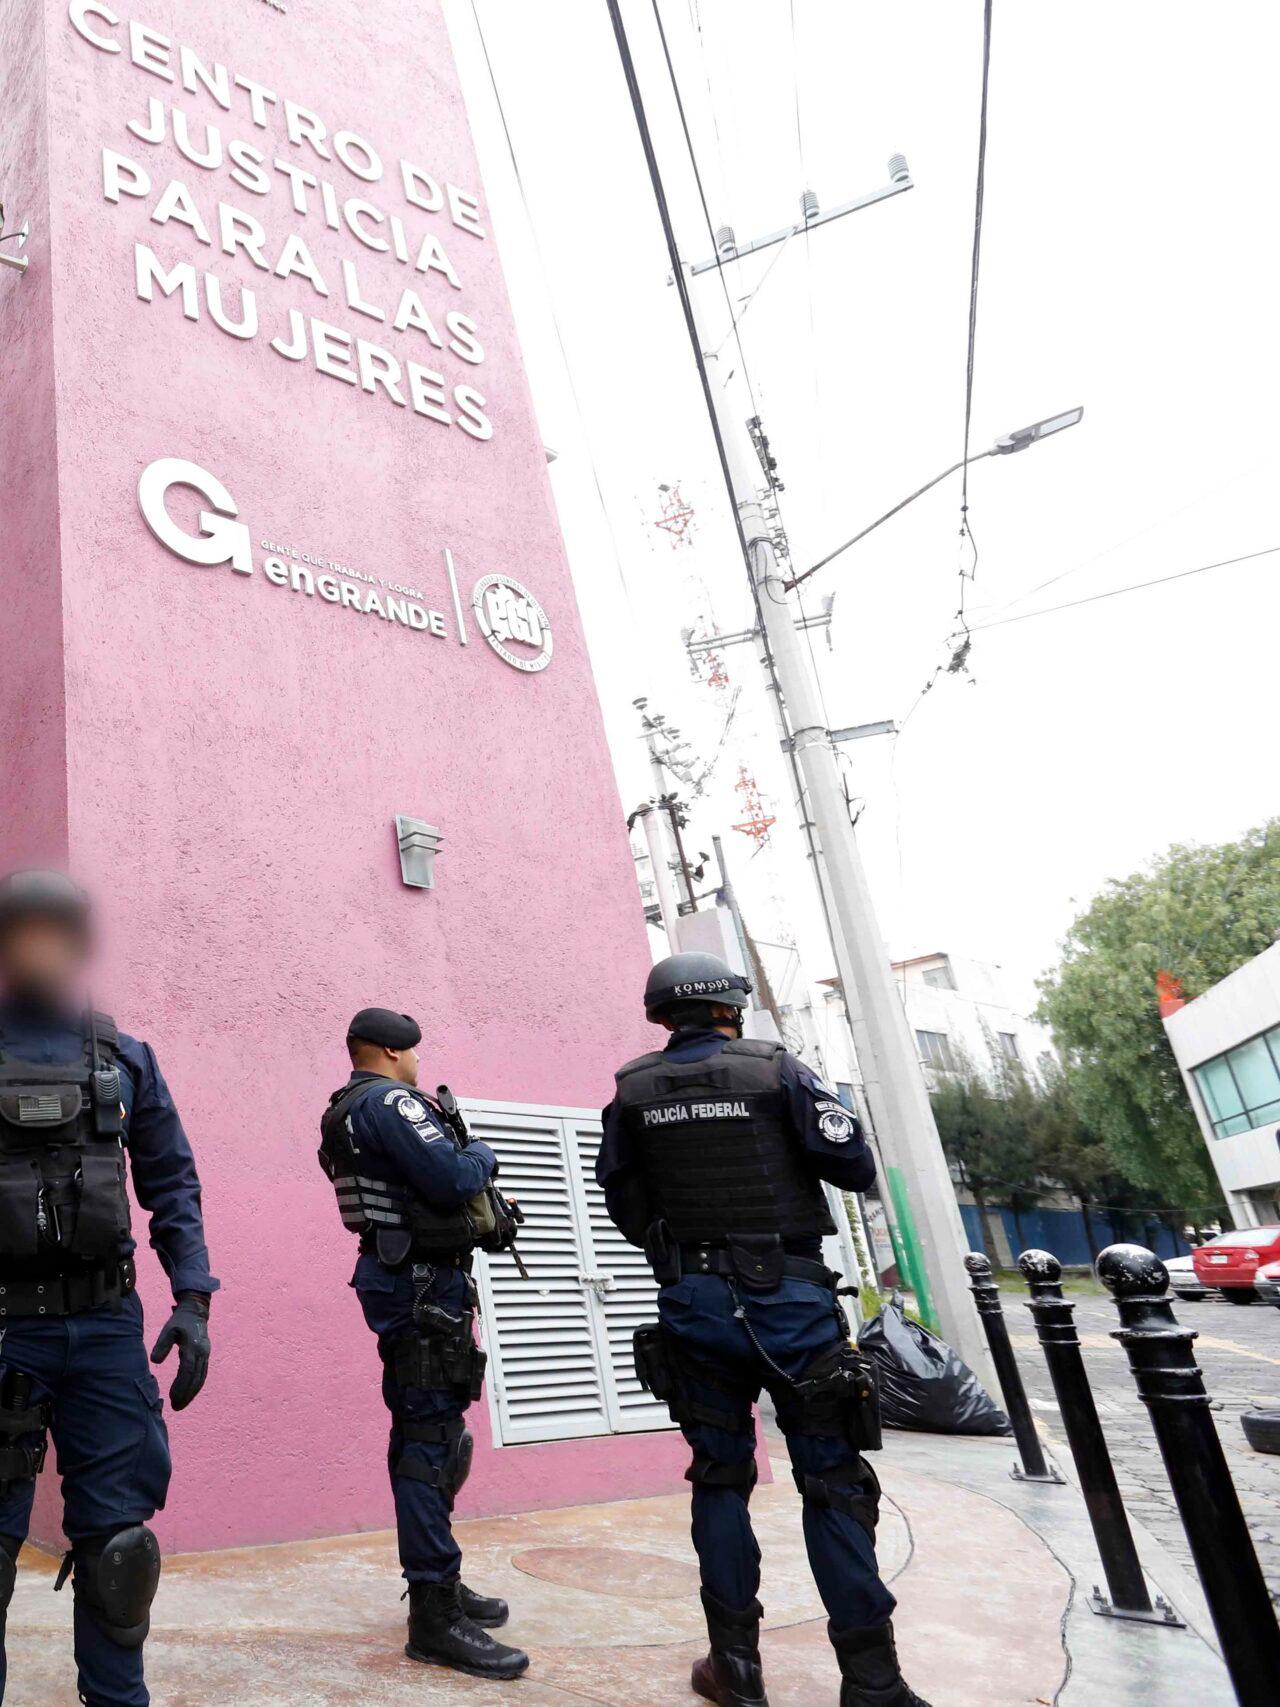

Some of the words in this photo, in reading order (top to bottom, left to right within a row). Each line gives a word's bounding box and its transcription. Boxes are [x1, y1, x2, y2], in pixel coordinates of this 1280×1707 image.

[69, 0, 383, 183] CENTRO
[400, 158, 486, 240] DE
[102, 147, 329, 297] PARA
[342, 259, 485, 365] LAS
[126, 96, 462, 290] JUSTICIA
[134, 242, 494, 441] MUJERES
[261, 540, 299, 559] GENTE
[301, 553, 324, 568] QUE
[327, 562, 376, 584] TRABAJA
[378, 578, 386, 588] Y
[389, 582, 424, 600] LOGRA
[263, 556, 448, 639] enGRANDE
[674, 978, 729, 994] KOMODO
[643, 1104, 689, 1125] POLICÍA
[691, 1102, 749, 1119] FEDERAL
